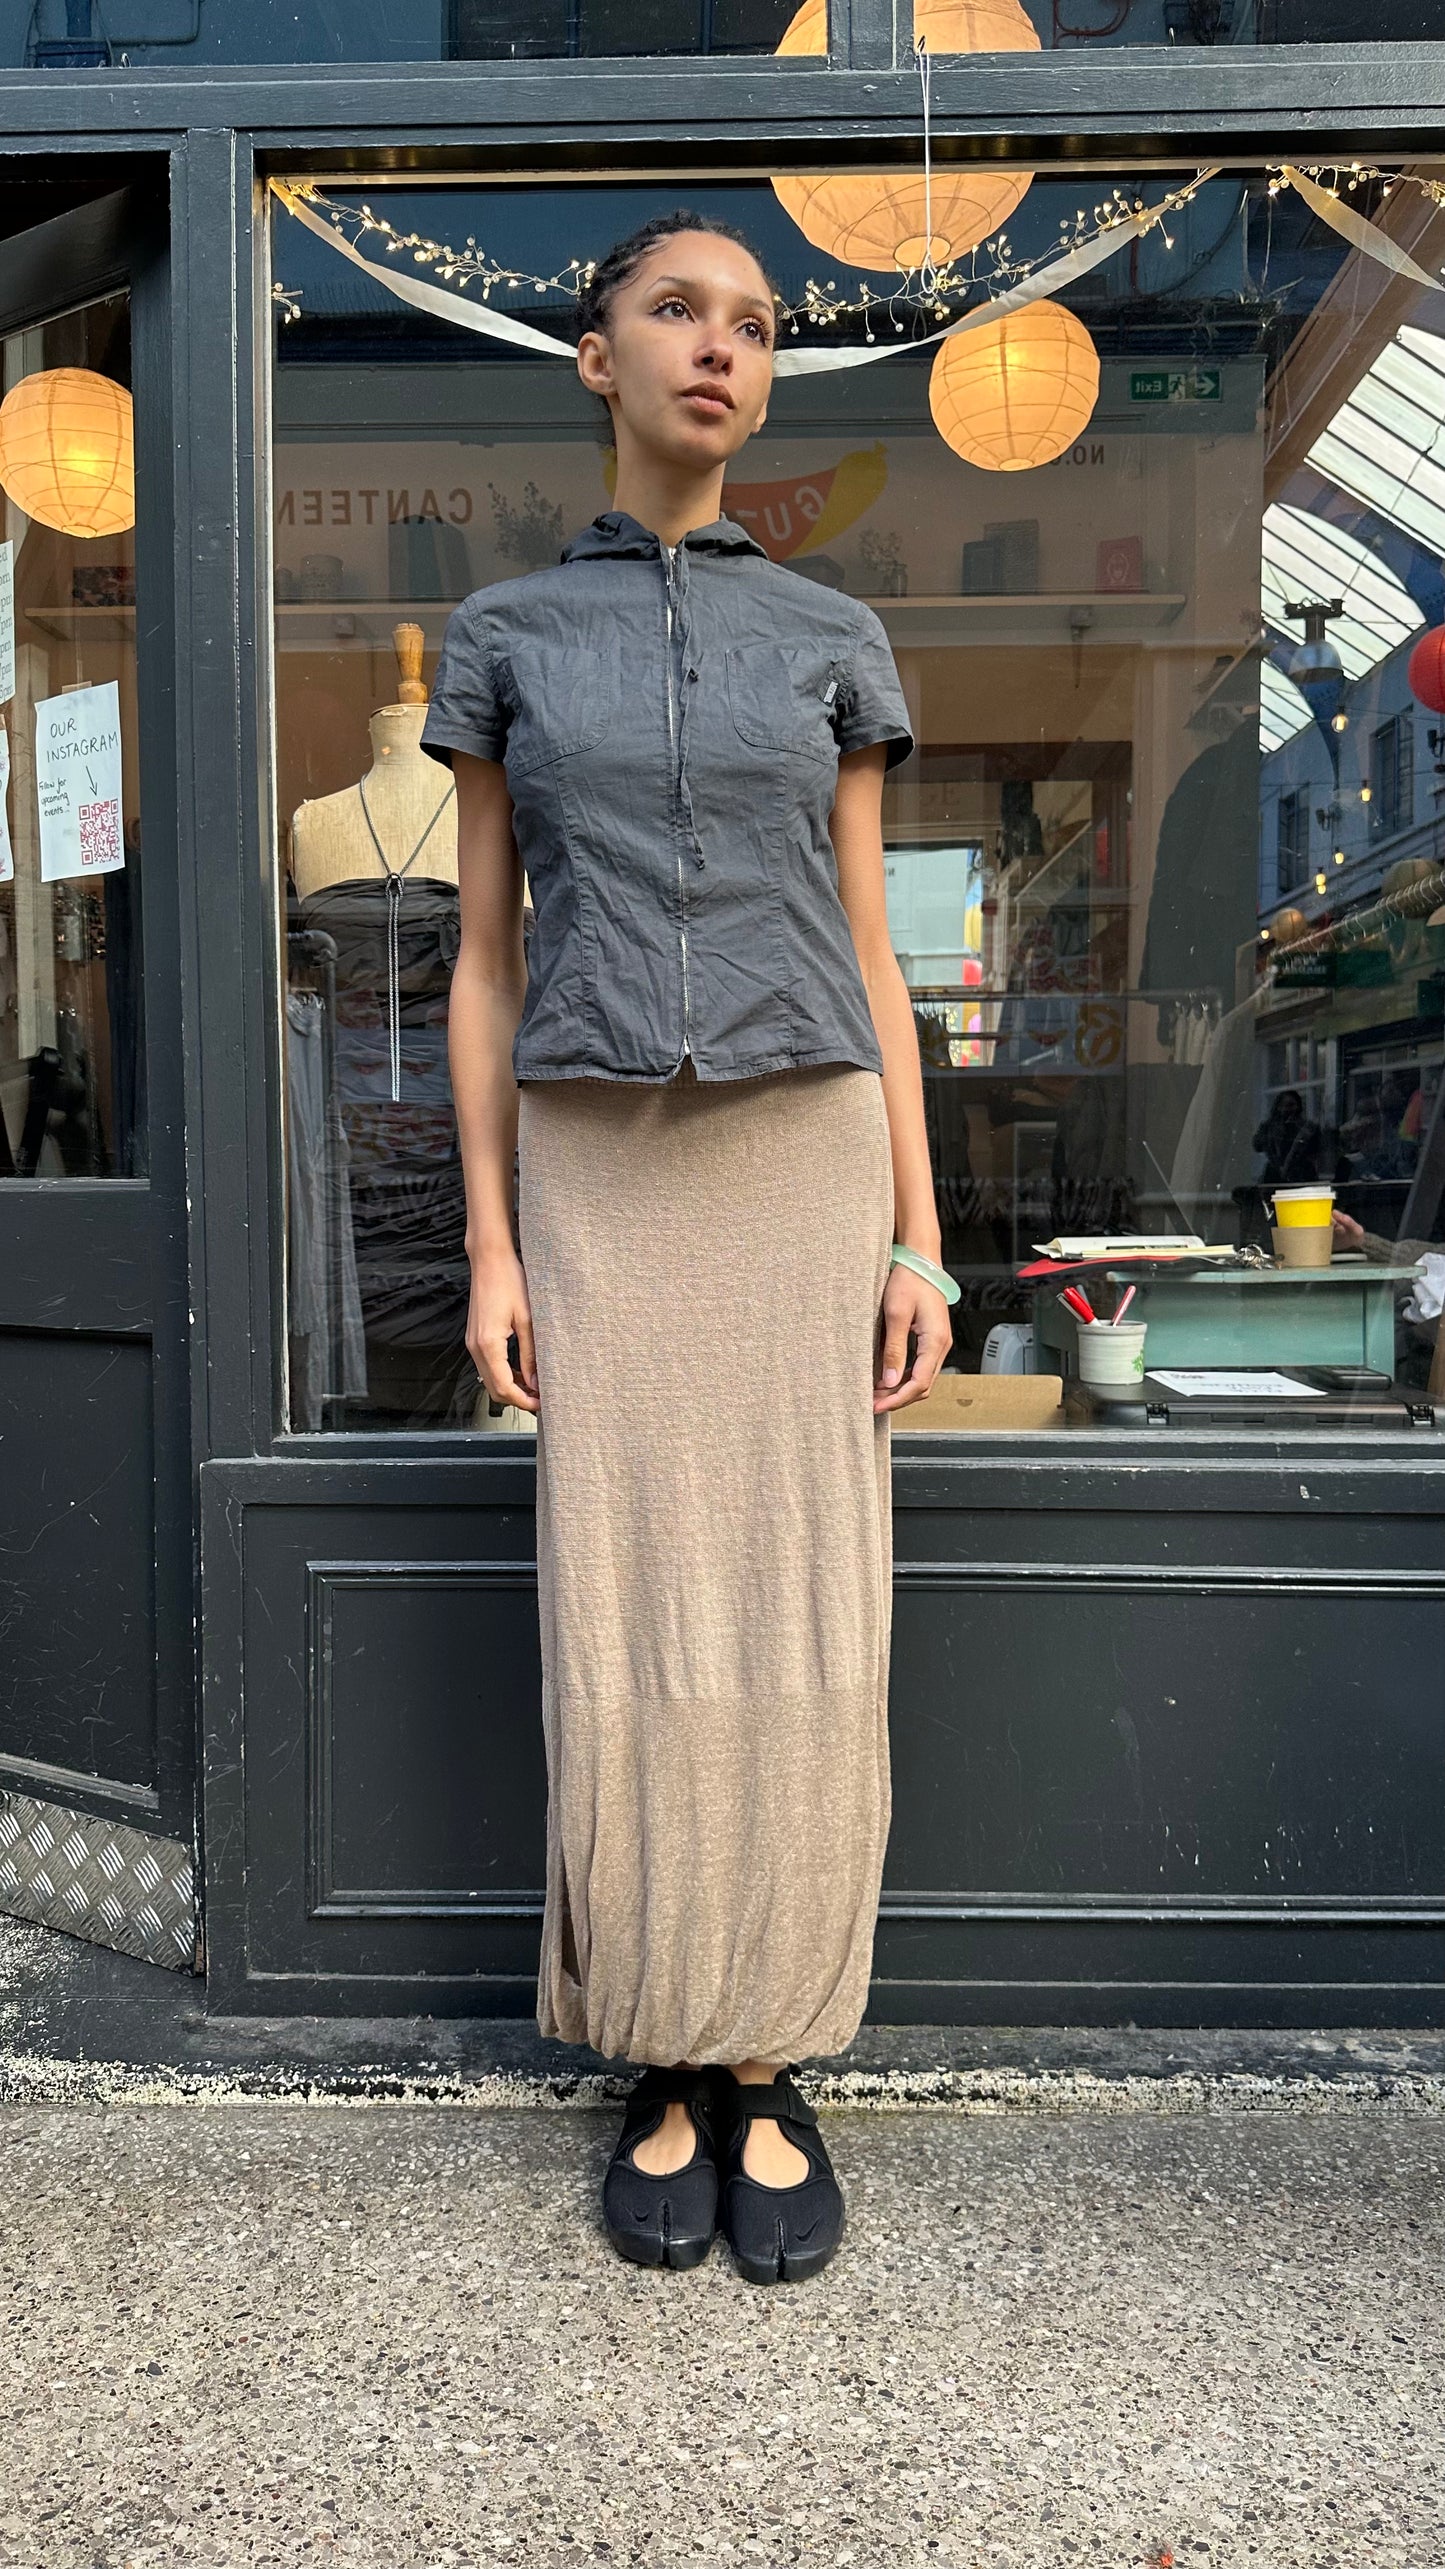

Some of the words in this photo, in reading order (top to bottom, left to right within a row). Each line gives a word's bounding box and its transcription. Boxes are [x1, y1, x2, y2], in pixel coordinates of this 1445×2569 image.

[50, 717, 77, 739] OUR
[46, 731, 118, 762] INSTAGRAM
[57, 777, 67, 794] for
[41, 792, 70, 806] upcoming
